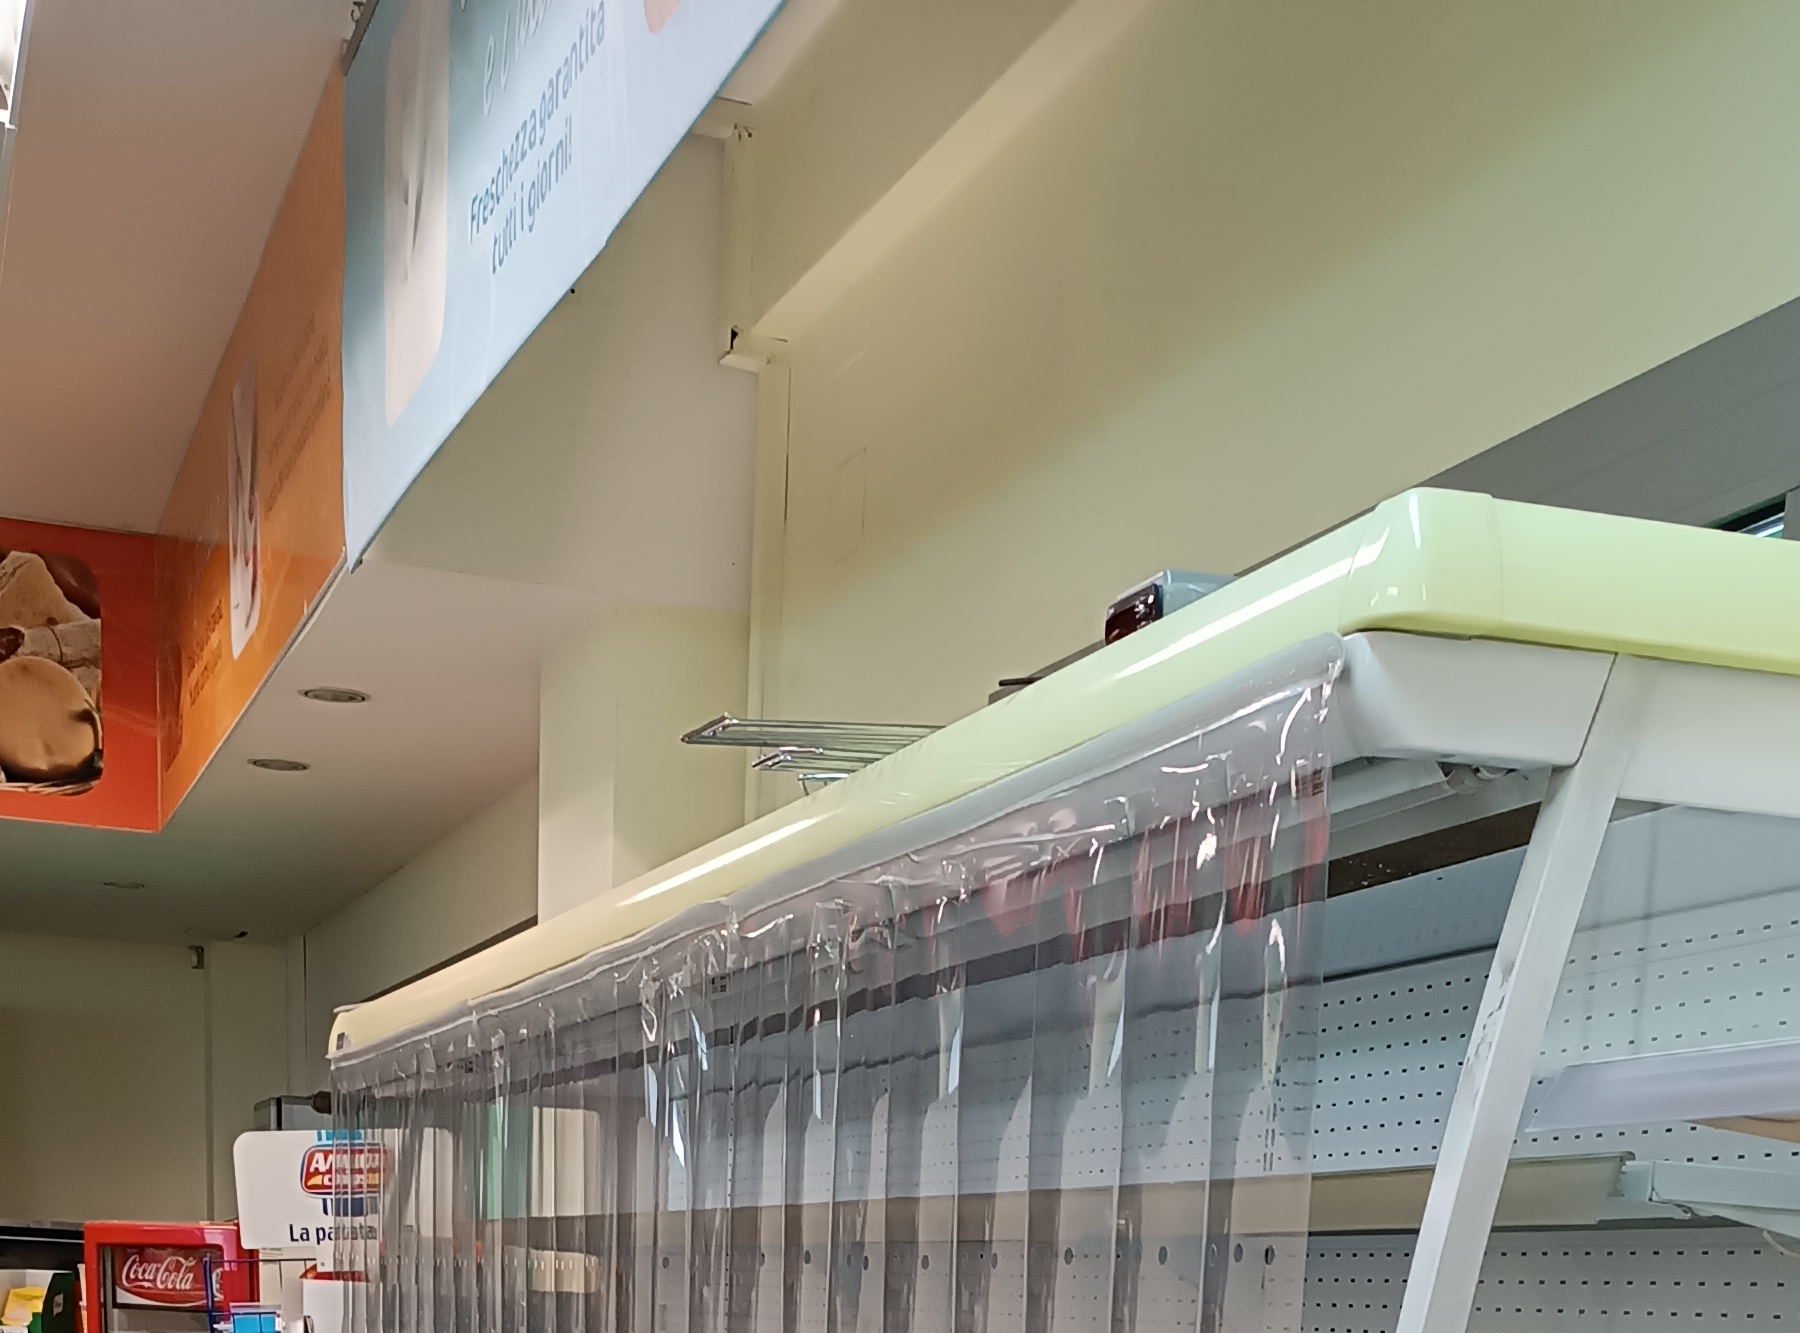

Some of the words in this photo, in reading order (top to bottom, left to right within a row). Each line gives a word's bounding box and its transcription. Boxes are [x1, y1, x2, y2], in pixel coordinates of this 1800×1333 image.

[468, 108, 538, 244] Freschezza
[538, 2, 606, 146] garantita
[492, 192, 518, 275] tutti
[519, 180, 525, 232] i
[527, 113, 573, 234] giorni!
[121, 1254, 198, 1290] Coca-Cola
[289, 1223, 310, 1242] La
[315, 1223, 378, 1246] patata
